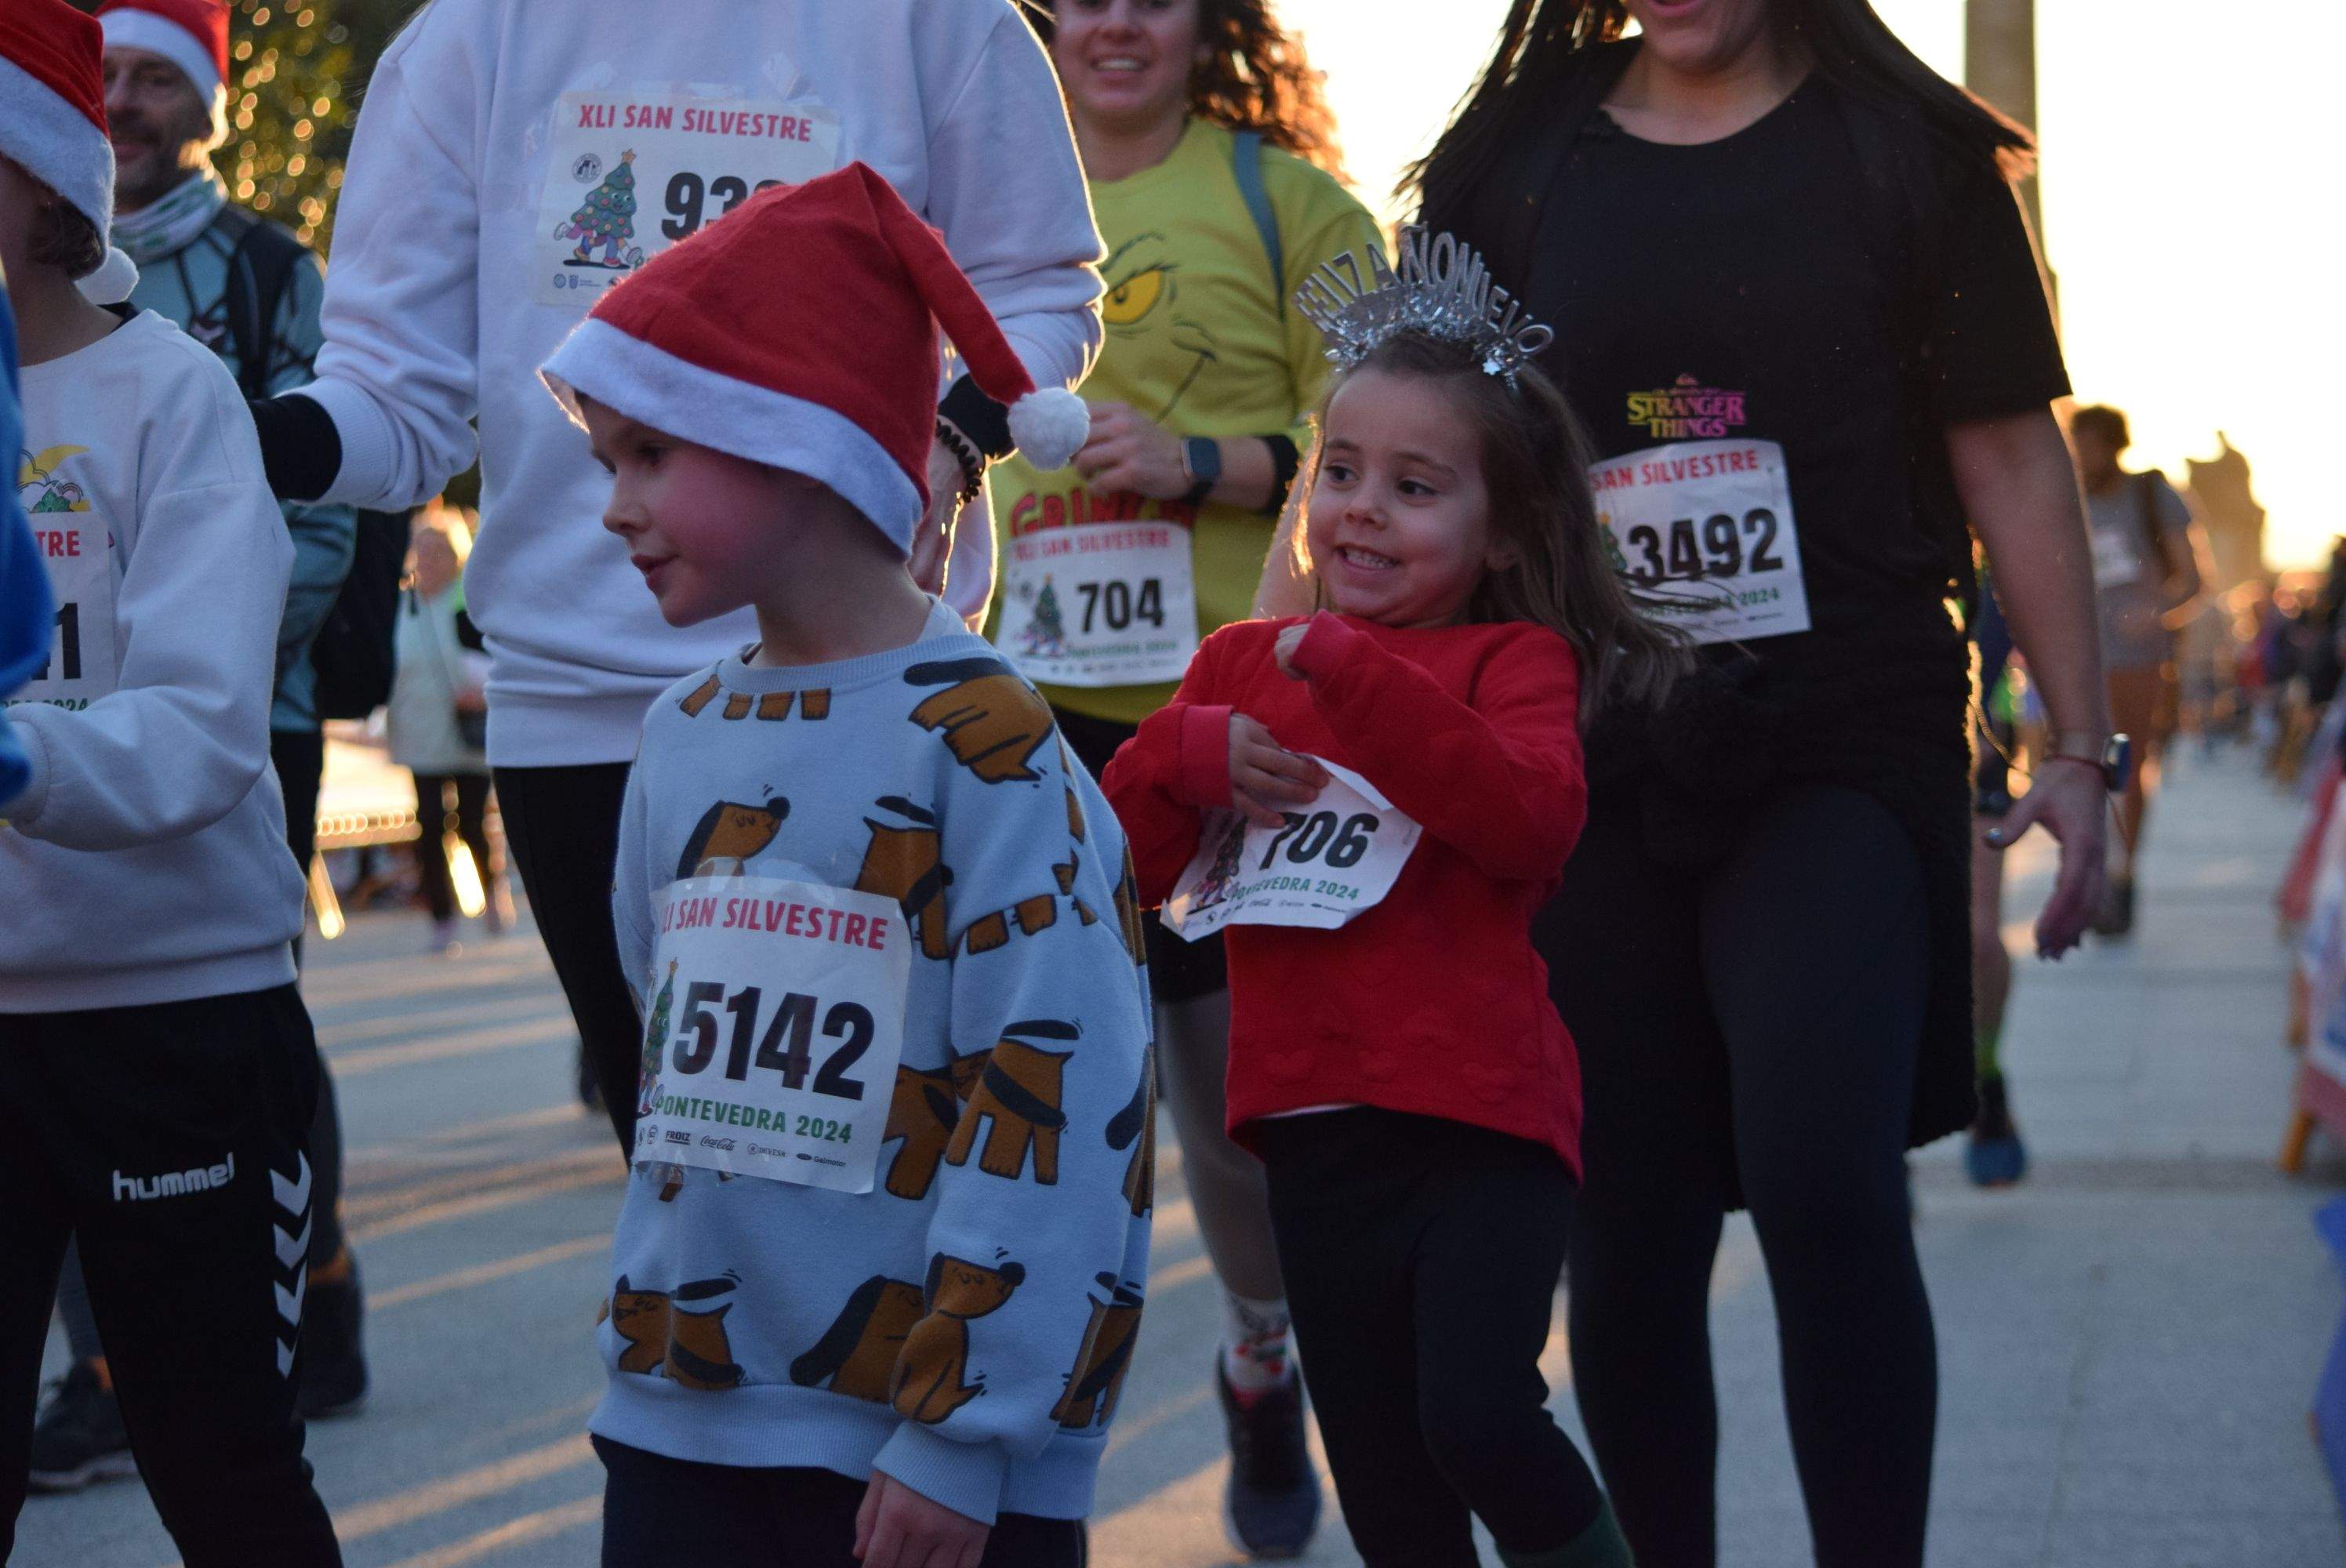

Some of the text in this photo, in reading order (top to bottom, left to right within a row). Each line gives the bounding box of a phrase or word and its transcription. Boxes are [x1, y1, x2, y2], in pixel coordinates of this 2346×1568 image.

[579, 104, 812, 142] XLI SAN SILVESTRE
[661, 172, 786, 241] 93
[1626, 391, 1745, 425] STRANGER
[1650, 417, 1727, 438] THINGS
[1589, 449, 1760, 492] SAN SILVESTRE
[1629, 507, 1784, 589] 3492
[1076, 578, 1164, 633] 704
[32, 602, 82, 681] 1
[1259, 811, 1379, 871] 706
[1314, 880, 1359, 900] 2024
[676, 898, 717, 930] SAN
[723, 898, 888, 951] SILVESTRE
[672, 981, 875, 1102] 5142
[654, 1095, 852, 1144] PONTEVEDRA 2024
[665, 1131, 691, 1142] FROIZ
[113, 1151, 235, 1202] hummel
